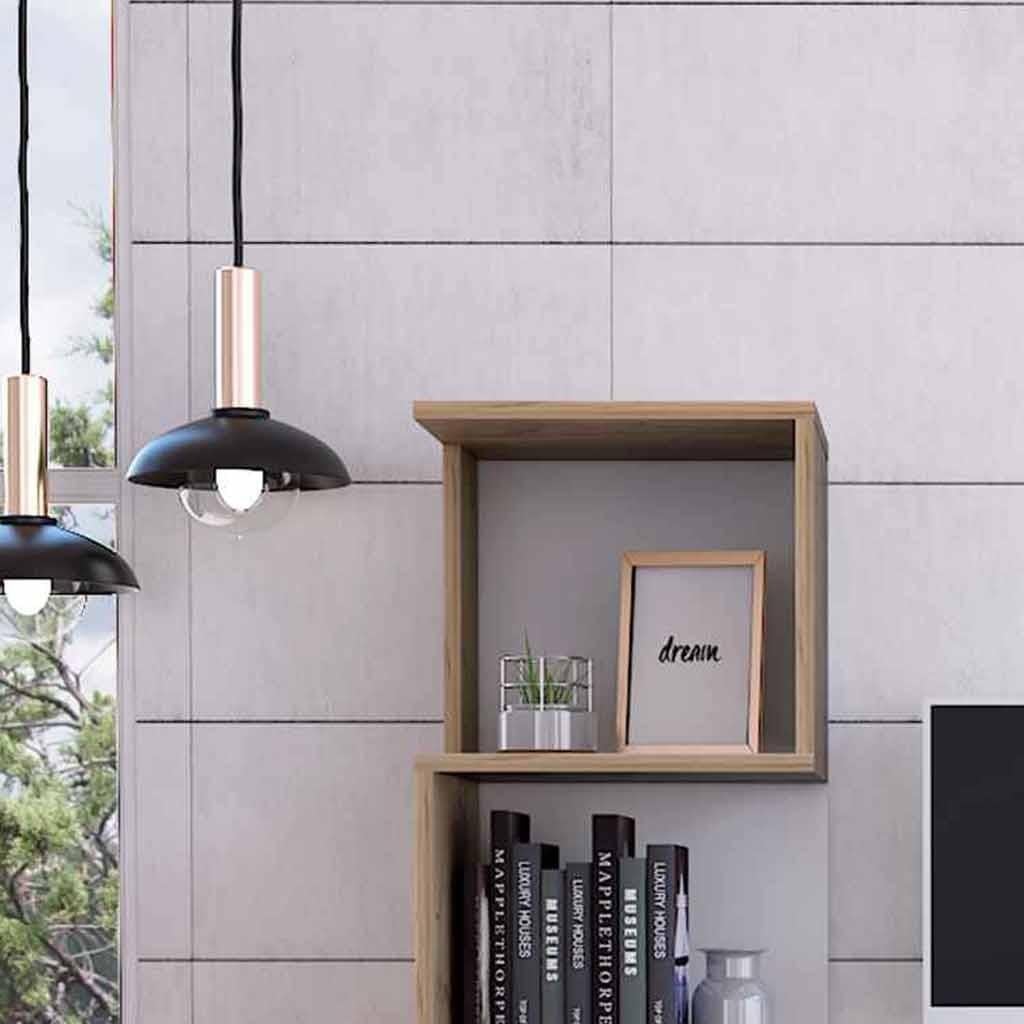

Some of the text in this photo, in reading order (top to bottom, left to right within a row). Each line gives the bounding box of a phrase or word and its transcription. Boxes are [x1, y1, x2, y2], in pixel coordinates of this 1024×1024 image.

[658, 635, 721, 662] dream
[494, 848, 506, 1024] MAPPLETHORPE
[518, 861, 532, 959] LUXURY HOUSES
[545, 898, 559, 982] MUSEUMS
[571, 879, 584, 969] LUXURY HOUSES
[623, 888, 637, 977] MUSEUMS
[653, 862, 667, 960] LUXURY HOUSES
